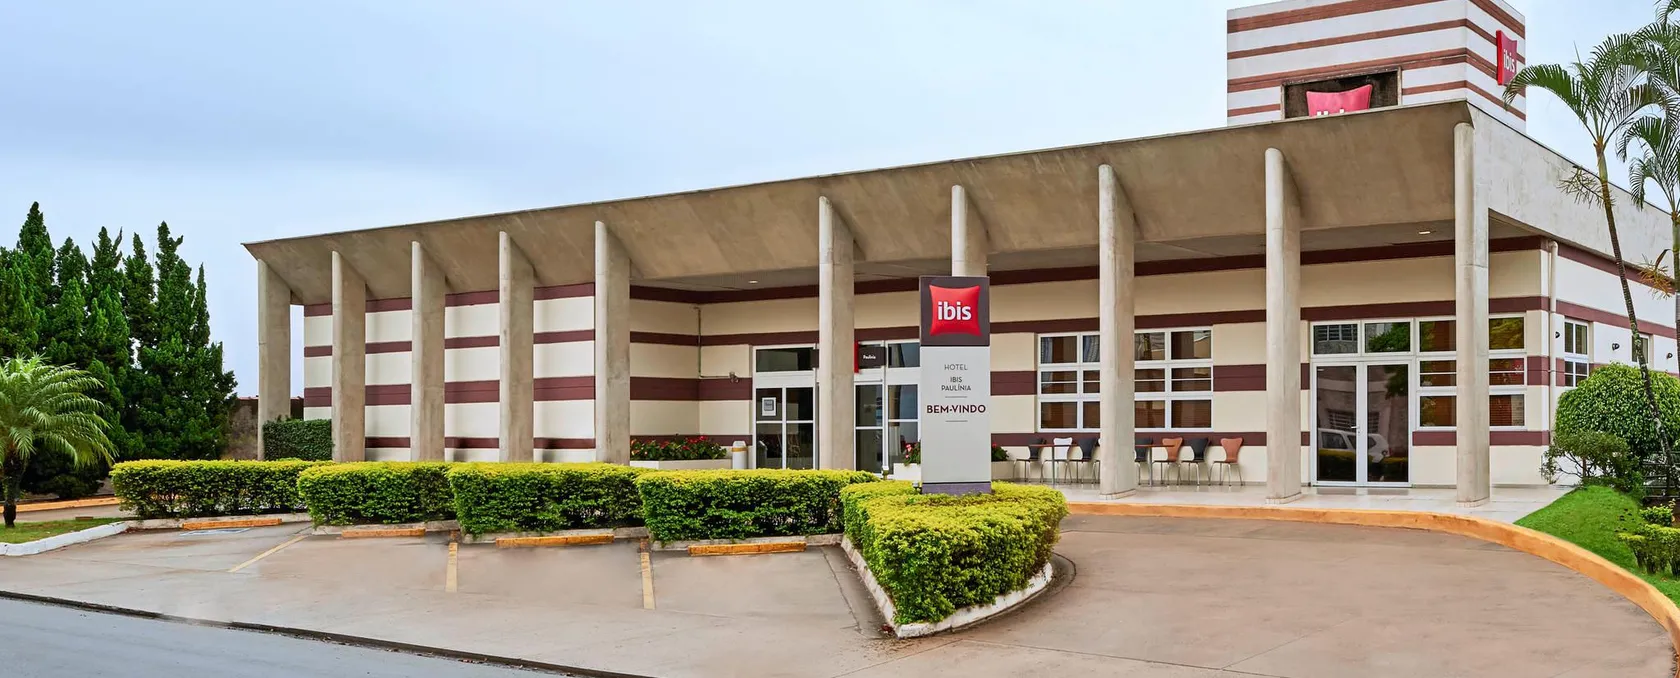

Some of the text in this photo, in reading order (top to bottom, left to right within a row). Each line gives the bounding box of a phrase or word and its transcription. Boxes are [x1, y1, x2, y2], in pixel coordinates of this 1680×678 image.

[1503, 49, 1515, 73] ibis
[937, 301, 972, 320] ibis
[941, 384, 972, 392] PAULÍNIA
[926, 404, 986, 414] BEM-VINDO
